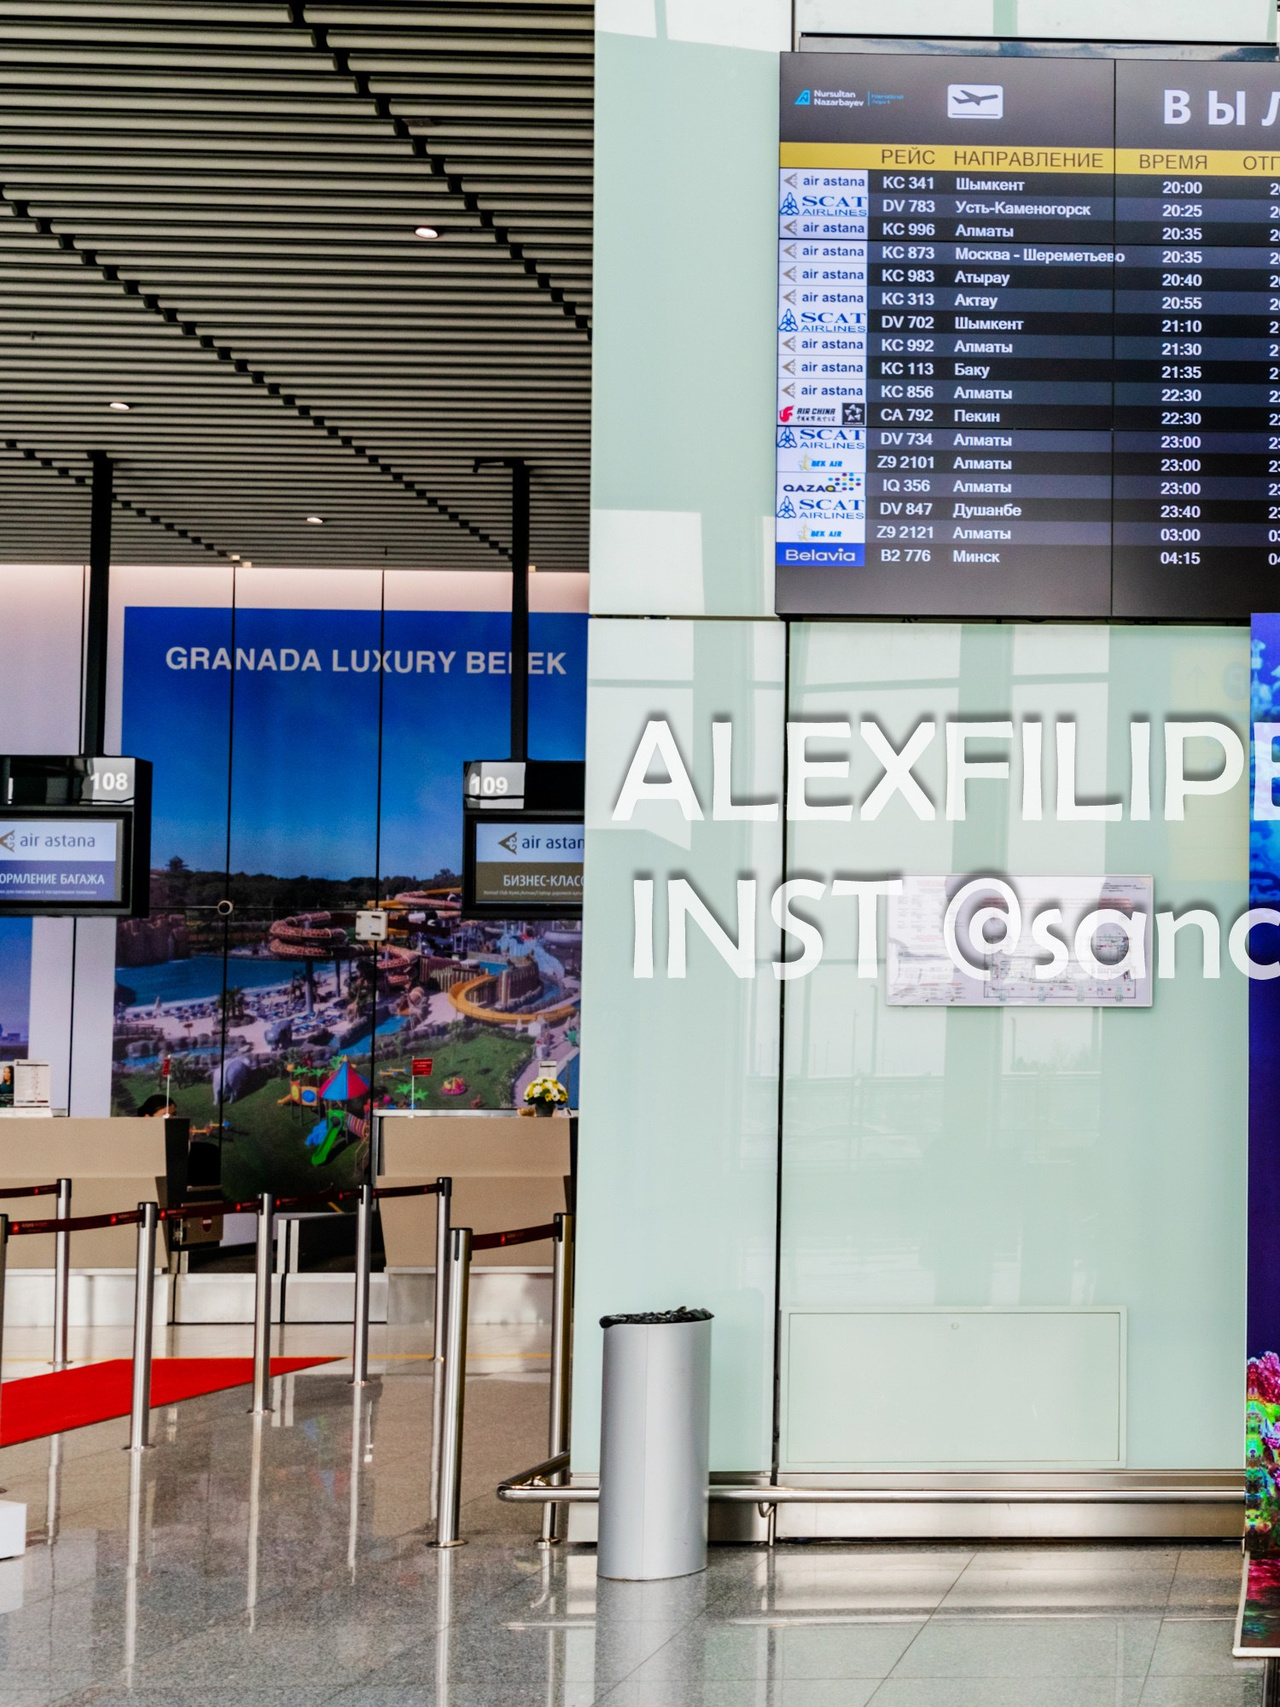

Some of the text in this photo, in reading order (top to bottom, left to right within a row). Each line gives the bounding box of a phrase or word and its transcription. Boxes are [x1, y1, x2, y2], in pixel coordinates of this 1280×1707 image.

[814, 90, 856, 98] Nursultan
[814, 98, 864, 108] Nazarbayev
[882, 146, 935, 164] РЕЙС
[955, 151, 1103, 167] НАПРАВЛЕНИЕ
[1140, 154, 1207, 169] ВРЕМЯ
[803, 176, 865, 187] air astana
[883, 176, 904, 189] KC
[909, 176, 933, 189] 341
[956, 178, 1025, 190] Шымкент
[1163, 181, 1202, 194] 20:00
[802, 196, 867, 208] SCAT
[883, 200, 1091, 218] DV 783 Усть-Каменогорск
[802, 208, 867, 217] AIRLINES
[883, 223, 1013, 237] KC 996 Алматы
[883, 246, 904, 259] KC
[908, 246, 934, 259] 873
[956, 248, 1010, 260] Москва
[1023, 248, 1125, 265] Шереметьево
[1163, 251, 1202, 263] 20:35
[882, 269, 1010, 286] KC 983 Атырау
[882, 293, 998, 309] KC 313 Актау
[882, 316, 904, 328] DV
[908, 316, 934, 328] 702
[955, 317, 1024, 330] Шымкент
[1162, 320, 1201, 332] 21:10
[802, 339, 864, 349] air astana
[882, 339, 1012, 353] KC 992 Алматы
[882, 362, 903, 375] KC
[908, 362, 933, 375] 113
[955, 363, 990, 379] Баку
[1162, 366, 1201, 378] 21:35
[881, 386, 1012, 399] KC 856 Алматы
[881, 409, 903, 421] CA
[907, 409, 933, 421] 792
[954, 410, 1000, 422] Пекин
[1162, 412, 1201, 424] 22:30
[881, 433, 1012, 446] DV 734 Алматы
[877, 456, 1012, 469] Z9 2101 Алматы
[783, 484, 836, 492] QAZAQ
[883, 479, 1011, 493] IQ 356 Алматы
[881, 503, 902, 515] DV
[906, 503, 932, 515] 847
[953, 503, 1021, 518] Душанбе
[1161, 506, 1200, 517] 23:40
[877, 526, 1011, 539] Z9 2121 Алматы
[786, 548, 856, 562] Belavia
[881, 549, 900, 562] B2
[904, 549, 930, 562] 776
[953, 550, 1000, 562] Минск
[1161, 552, 1200, 564] 04:15
[166, 646, 322, 672] GRANADA
[332, 648, 457, 675] LUXURY
[90, 772, 128, 791] 108
[469, 775, 509, 795] 109
[20, 832, 96, 848] air astana
[522, 835, 540, 849] air
[60, 874, 106, 885] БАГАЖА
